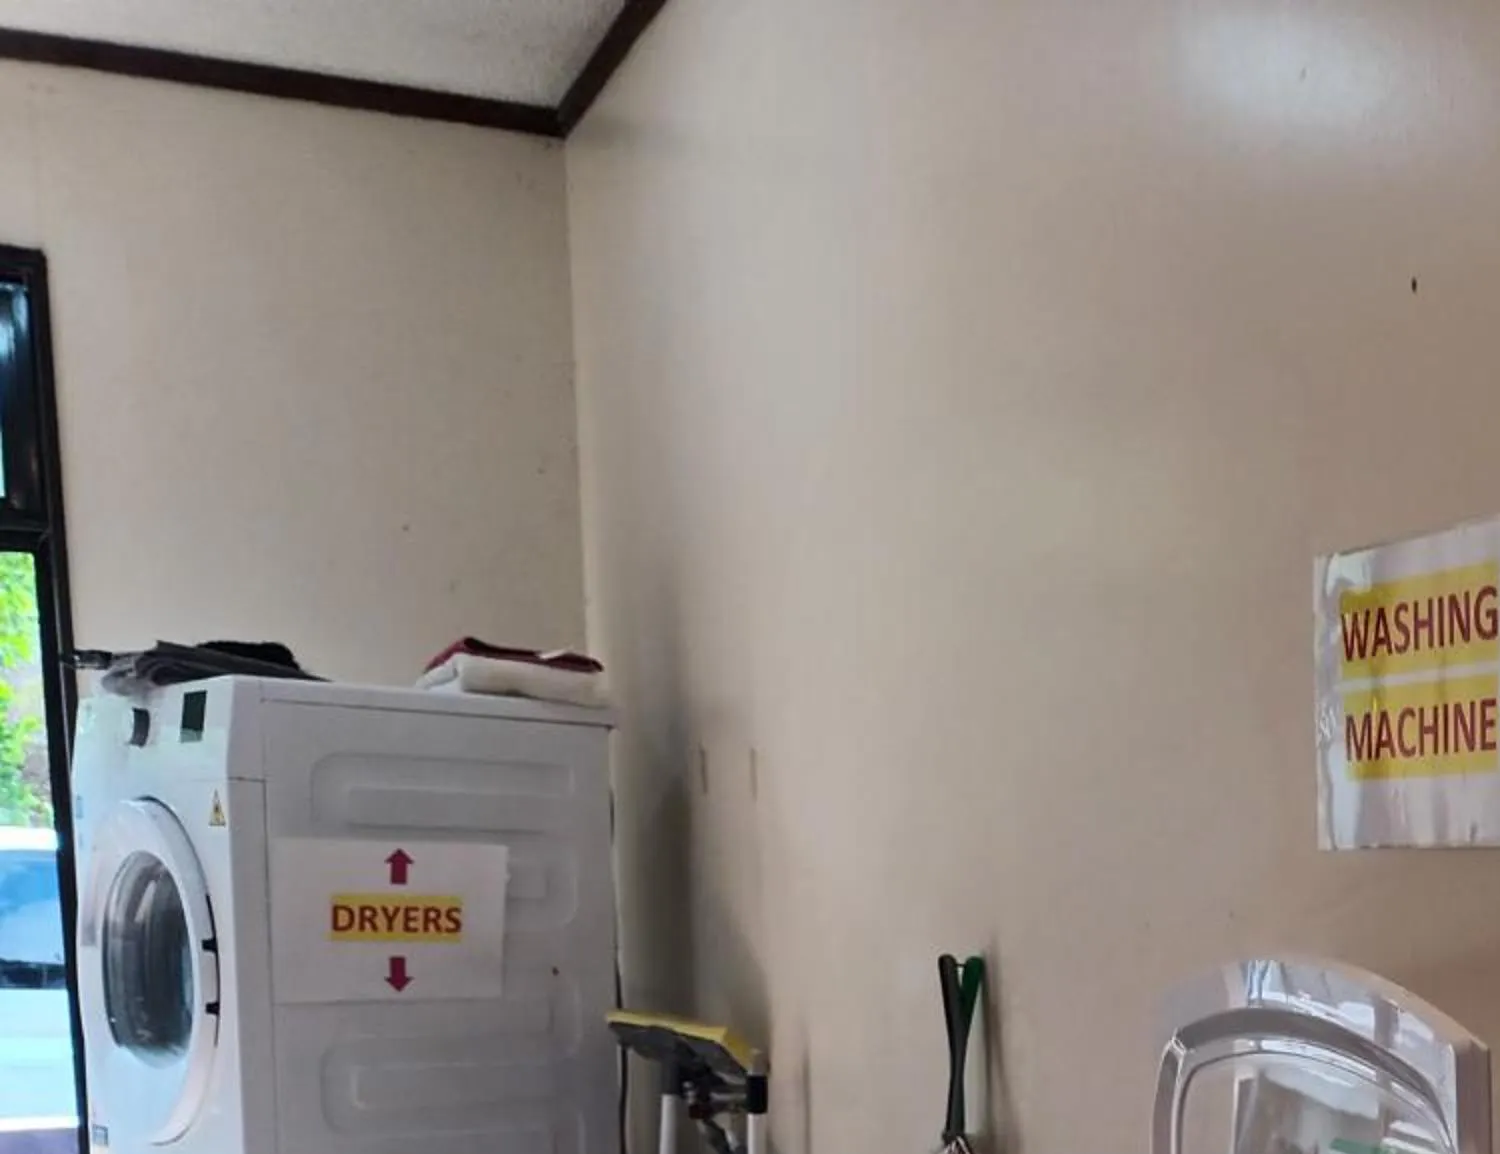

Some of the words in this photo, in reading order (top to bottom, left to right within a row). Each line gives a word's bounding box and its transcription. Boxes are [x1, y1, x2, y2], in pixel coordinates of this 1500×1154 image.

[1341, 586, 1499, 662] WASHING
[1345, 698, 1497, 761] MACHINE
[332, 904, 463, 934] DRYERS
